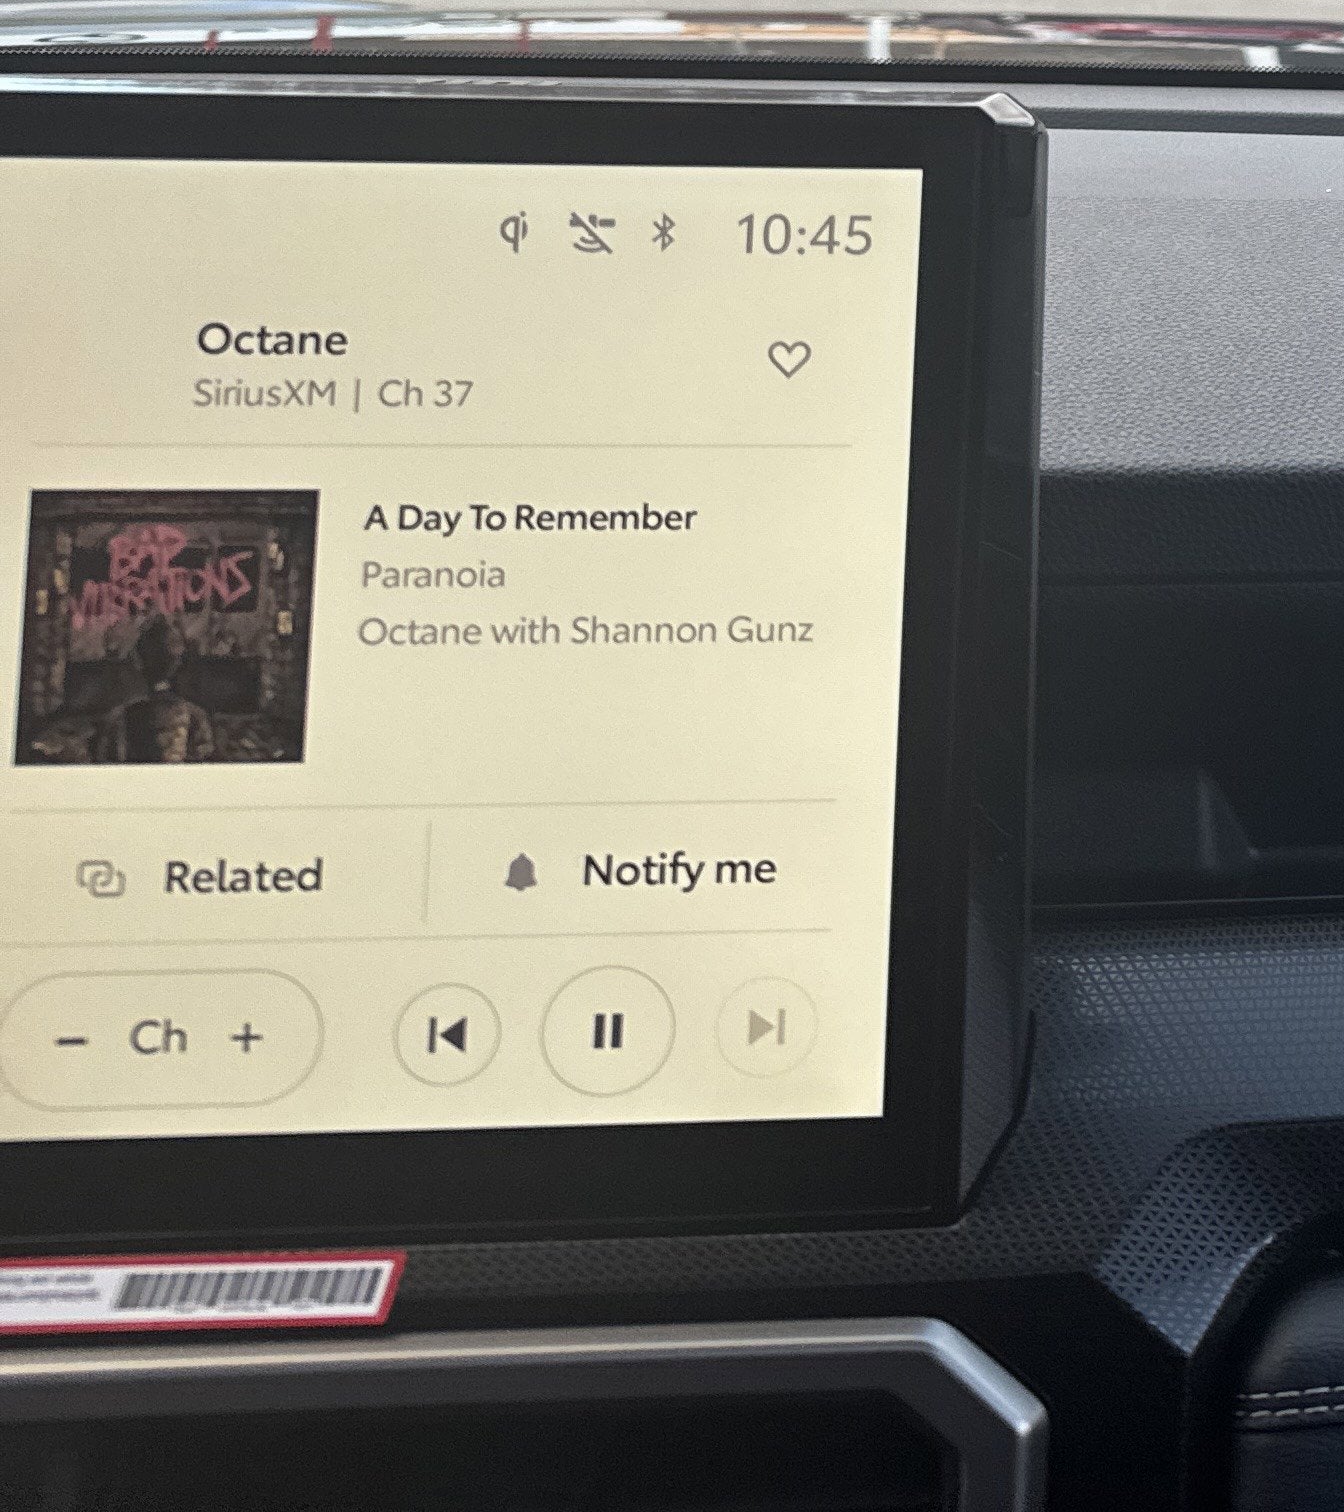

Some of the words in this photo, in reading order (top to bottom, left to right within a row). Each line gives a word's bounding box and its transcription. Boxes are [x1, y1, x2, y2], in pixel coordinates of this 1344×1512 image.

[737, 213, 875, 257] 10:45
[197, 323, 349, 358] Octane
[192, 378, 338, 410] SiriusXM
[378, 378, 424, 409] Ch
[431, 379, 474, 409] 37
[364, 504, 389, 532] A
[397, 504, 462, 538] Day
[470, 504, 506, 532] To
[514, 503, 698, 532] Remember
[361, 560, 507, 590] Paranoia
[358, 616, 482, 647] Octane
[491, 614, 561, 645] with
[571, 613, 718, 645] Shannon
[727, 614, 814, 644] Gunz
[163, 859, 324, 894] Related
[583, 851, 706, 891] Notify
[715, 857, 778, 887] me
[130, 1019, 187, 1055] Ch
